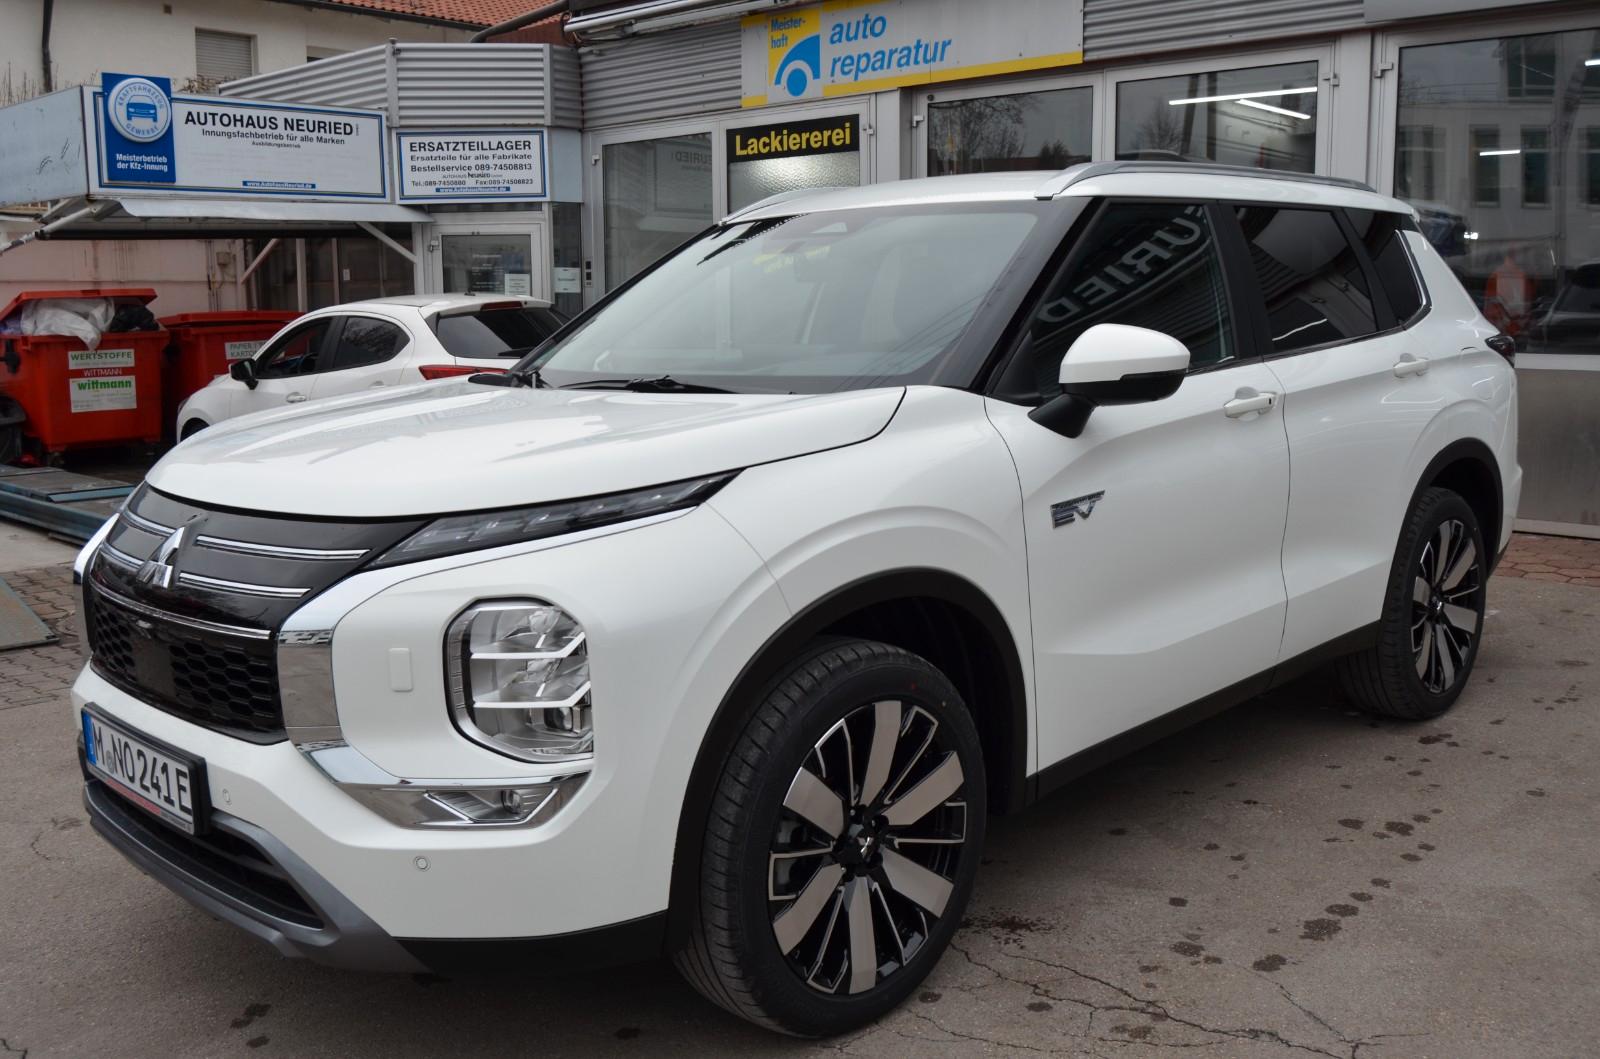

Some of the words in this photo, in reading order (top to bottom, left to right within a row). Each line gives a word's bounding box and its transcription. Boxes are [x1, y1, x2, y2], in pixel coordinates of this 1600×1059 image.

[771, 16, 806, 32] Meister-
[829, 15, 887, 45] auto
[771, 34, 789, 49] haft
[830, 38, 952, 82] reparatur
[185, 111, 279, 131] AUTOHAUS
[284, 117, 353, 136] NEURIED
[202, 128, 284, 142] Innungsfachbetrieb
[286, 132, 298, 142] für
[300, 135, 315, 144] alle
[316, 137, 345, 145] Marken
[735, 123, 851, 156] Lackiererei
[409, 140, 532, 152] ERSATZTEILLAGER
[116, 153, 168, 164] Meisterbetrieb
[411, 154, 457, 162] Ersatzteile
[474, 153, 490, 161] alle
[492, 153, 532, 161] Fabrikate
[116, 161, 129, 170] der
[130, 162, 168, 172] Kfz-Innung
[411, 164, 472, 173] Bestellservice
[474, 163, 532, 171] 089-74508813
[71, 351, 133, 361] WERTSTOFFE
[83, 368, 123, 377] WITTMANN
[77, 380, 132, 391] wittmann
[92, 722, 105, 766] M
